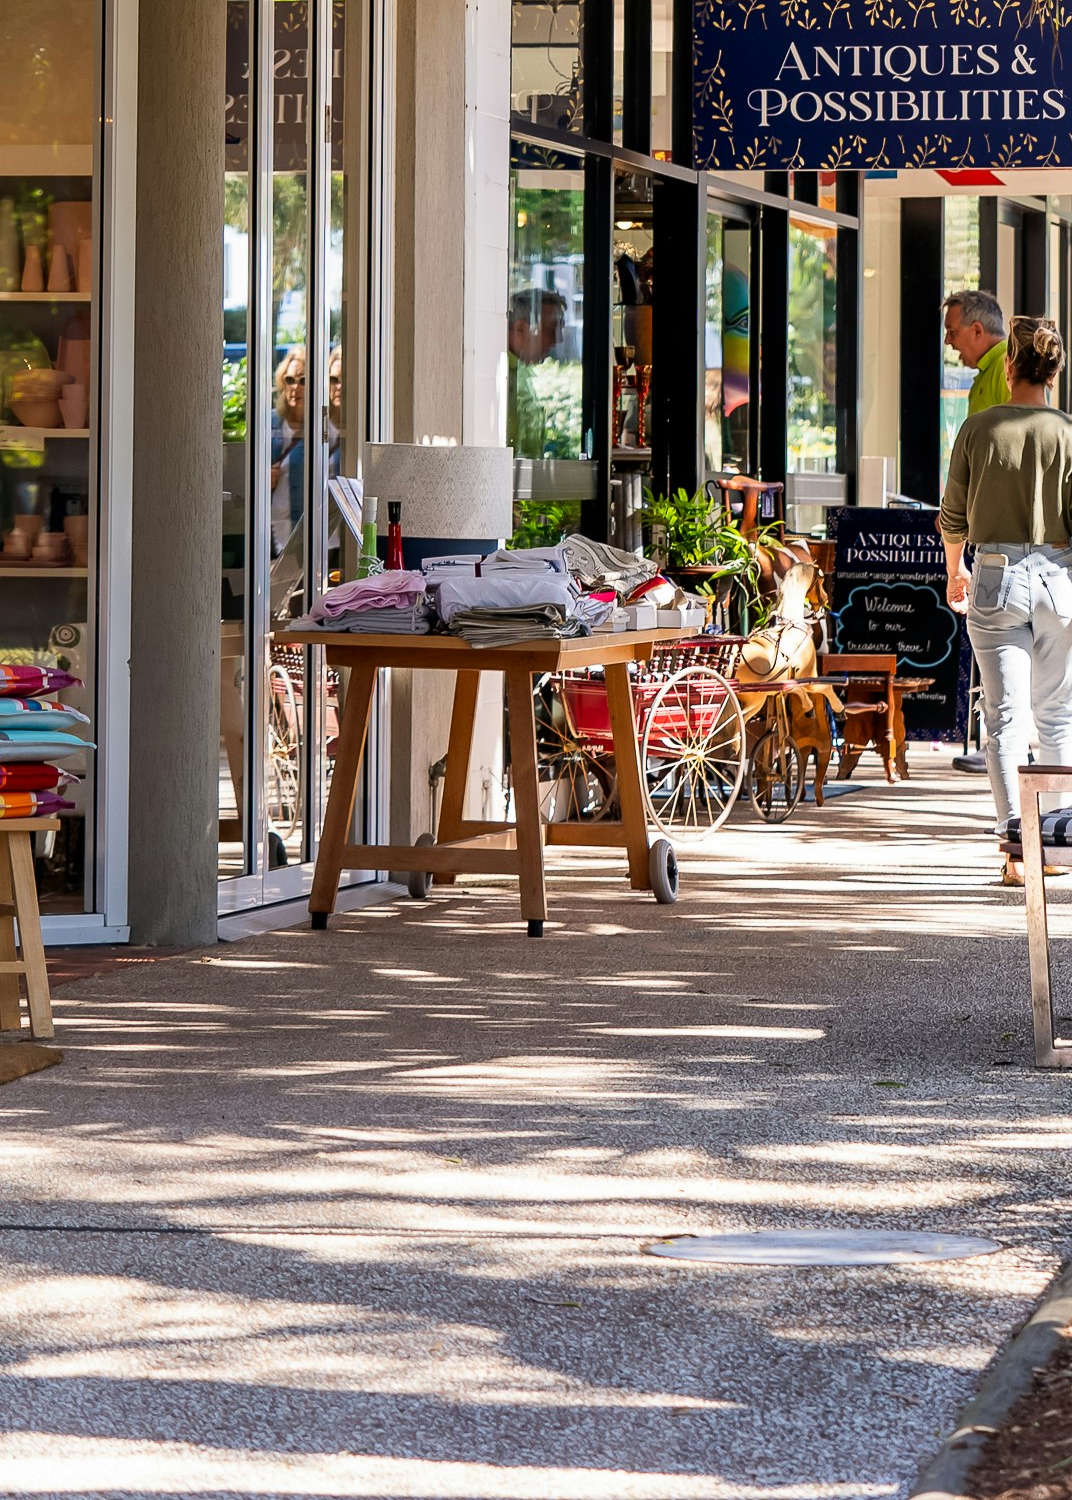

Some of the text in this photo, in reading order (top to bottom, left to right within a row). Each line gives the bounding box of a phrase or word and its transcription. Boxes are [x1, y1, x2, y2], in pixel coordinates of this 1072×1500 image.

[774, 41, 1037, 82] ANTIQUES &
[747, 87, 1067, 128] POSSIBILITIES
[853, 531, 937, 550] ANTIQUES
[864, 595, 915, 614] Welcome
[868, 619, 906, 632] to our
